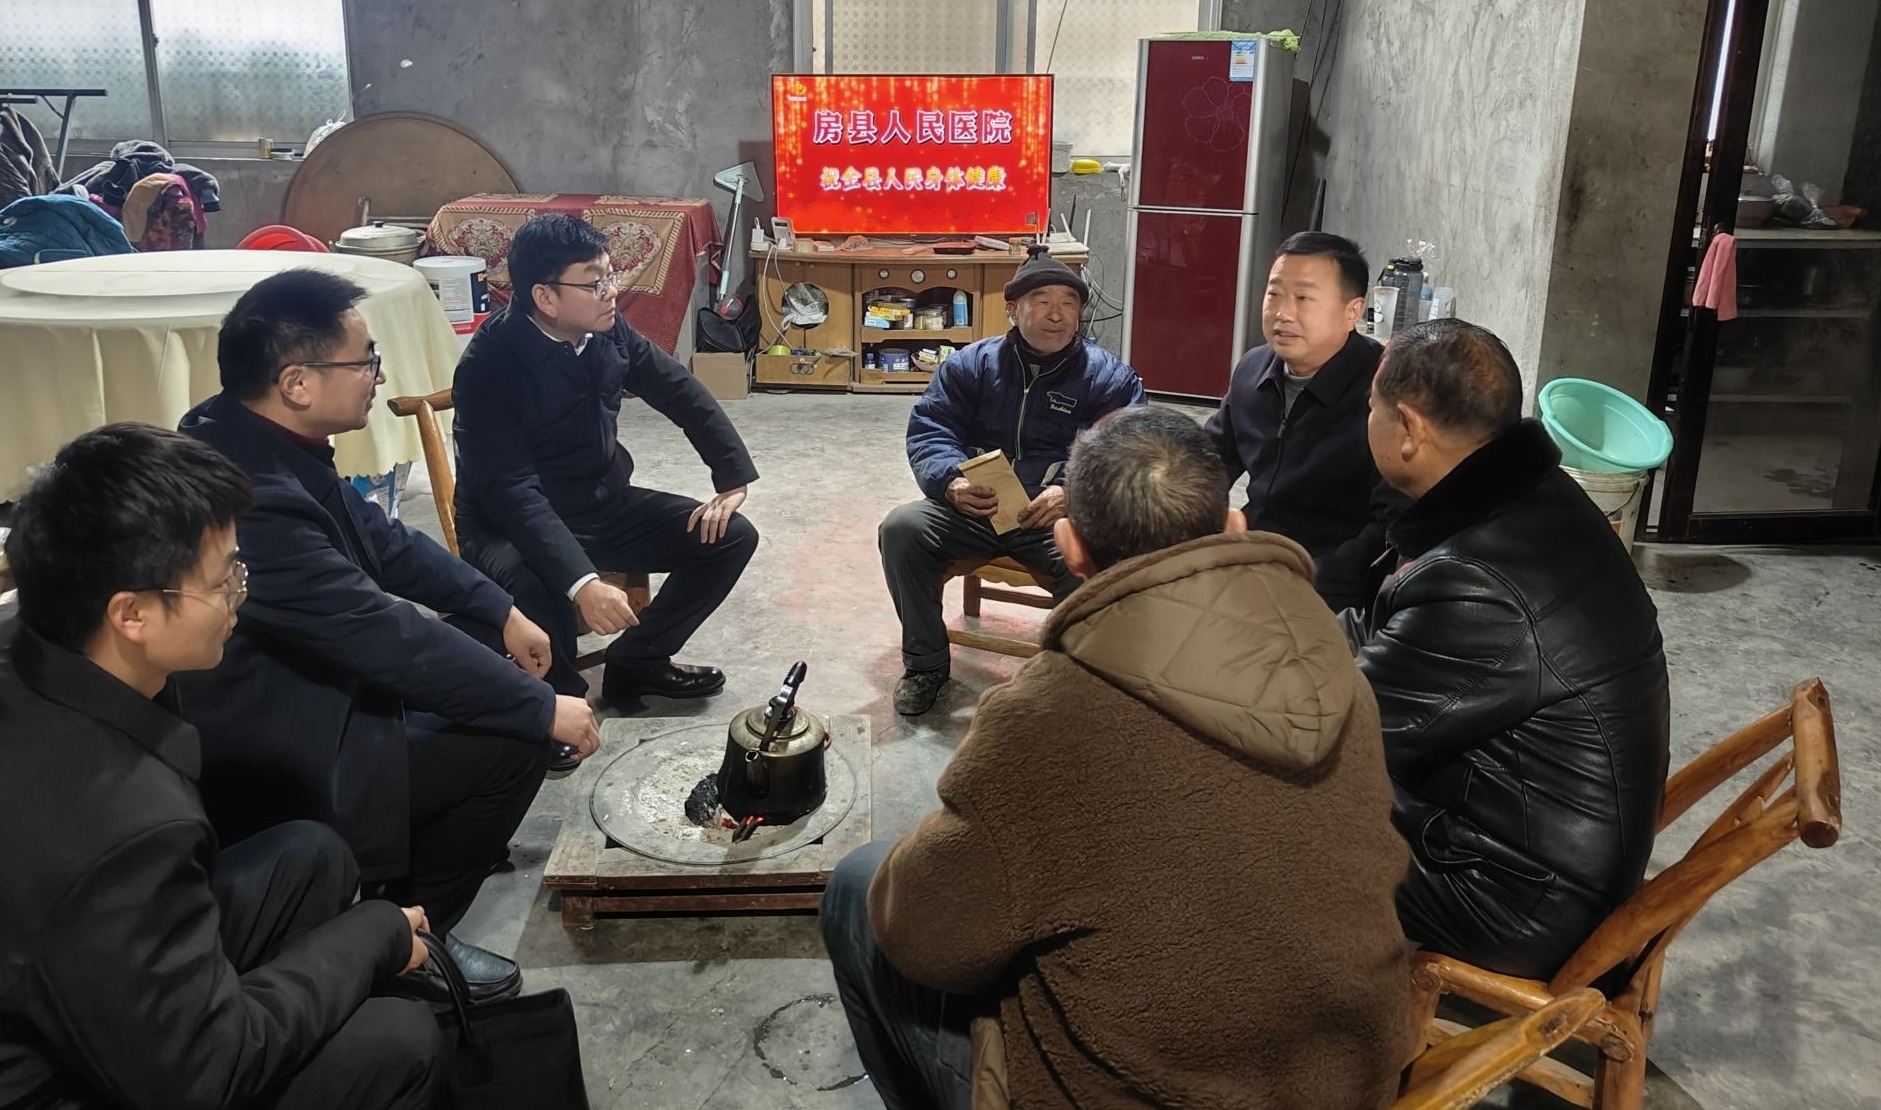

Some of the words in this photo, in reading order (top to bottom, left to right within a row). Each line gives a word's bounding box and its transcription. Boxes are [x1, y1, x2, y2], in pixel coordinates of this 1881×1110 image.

[813, 111, 1012, 144] 房县人民医院
[820, 166, 1006, 190] 祝全县人民身体健康
